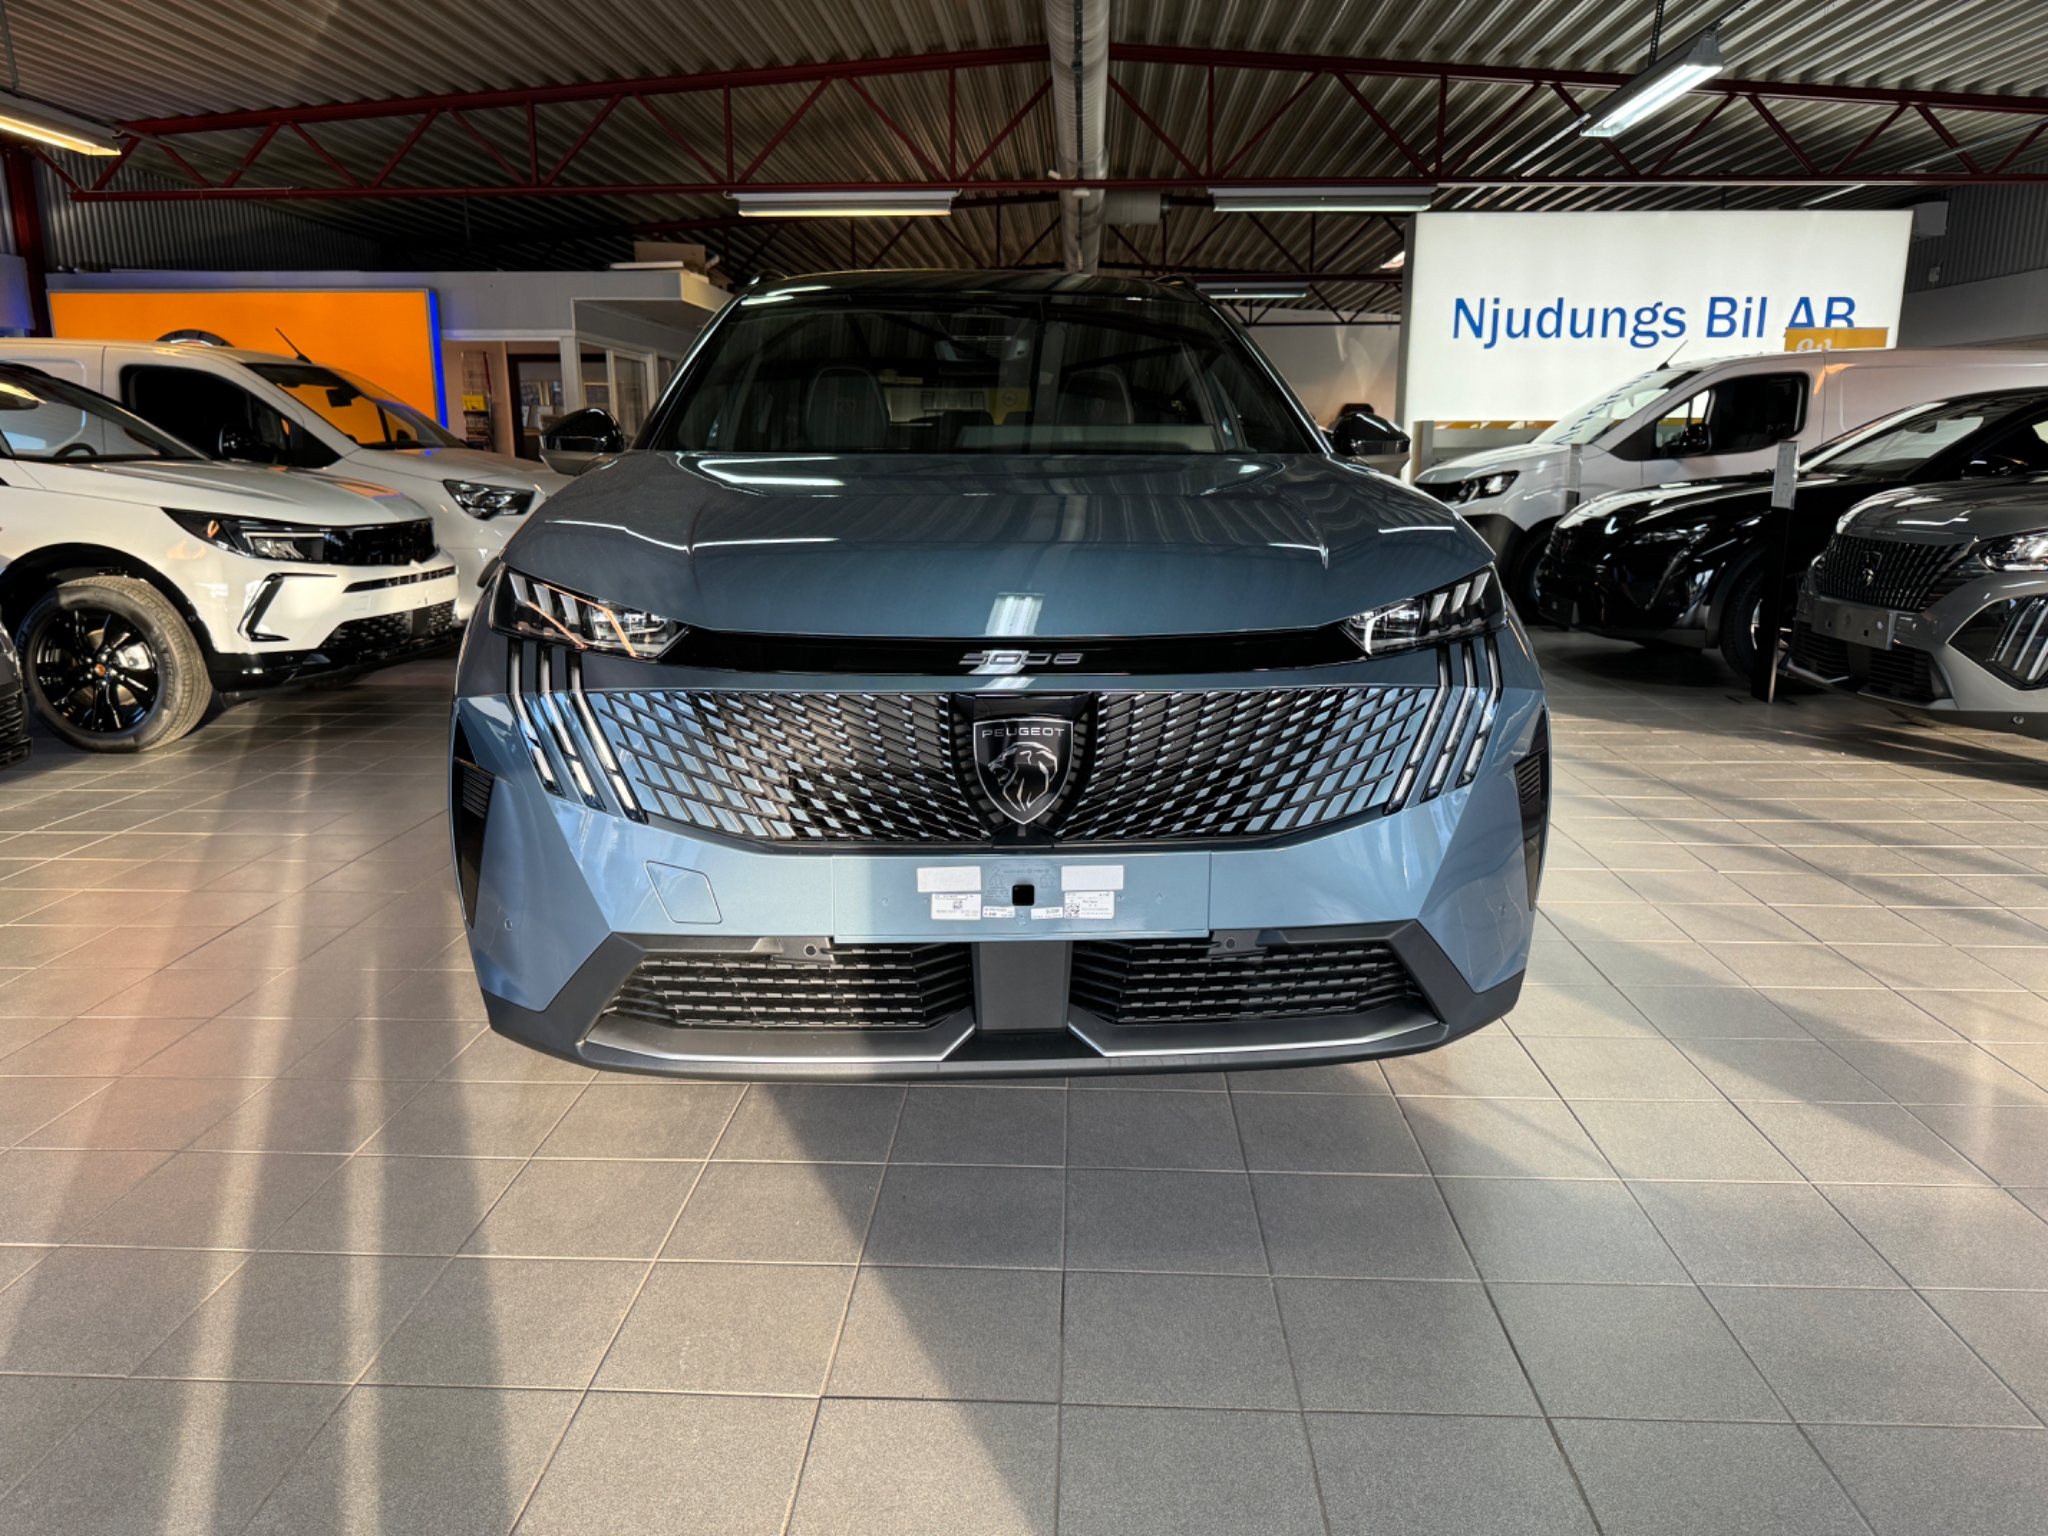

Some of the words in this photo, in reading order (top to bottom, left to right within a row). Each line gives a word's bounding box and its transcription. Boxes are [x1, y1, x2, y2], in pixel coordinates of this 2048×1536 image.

[1453, 297, 1687, 349] Njudungs
[1706, 296, 1768, 338] Bil
[981, 726, 1065, 739] PEUGEOT
